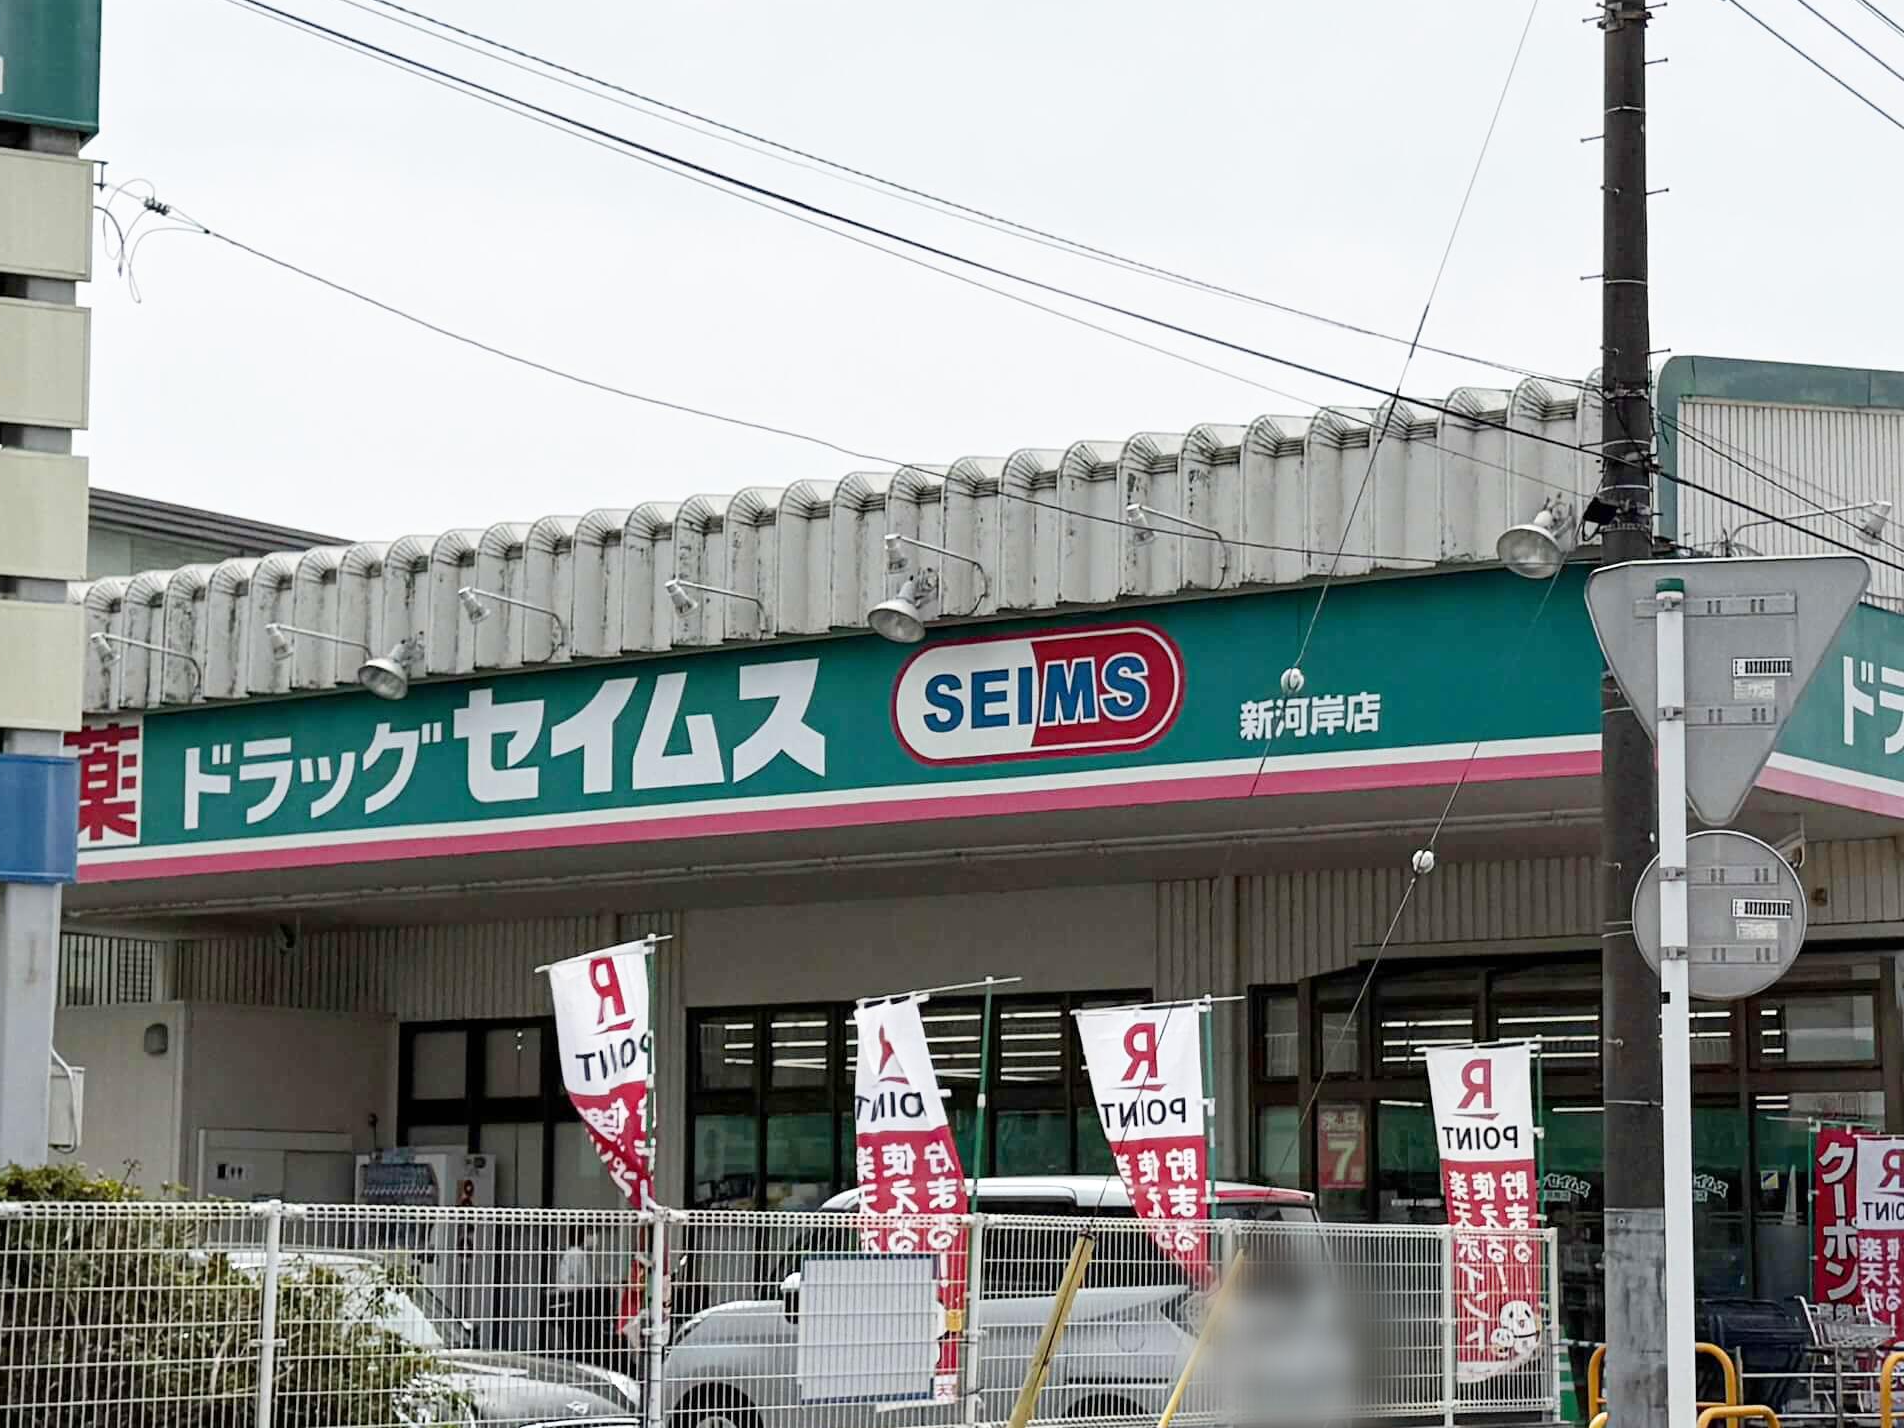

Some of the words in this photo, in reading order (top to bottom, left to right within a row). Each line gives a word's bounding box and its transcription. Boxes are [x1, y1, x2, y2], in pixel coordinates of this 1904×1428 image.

[181, 719, 445, 829] ドラッグ
[450, 657, 829, 803] セイムス
[923, 652, 1151, 733] SEIMS
[1239, 691, 1382, 741] 新河岸店
[64, 723, 140, 842] 薬
[1818, 1142, 1859, 1301] クーポン
